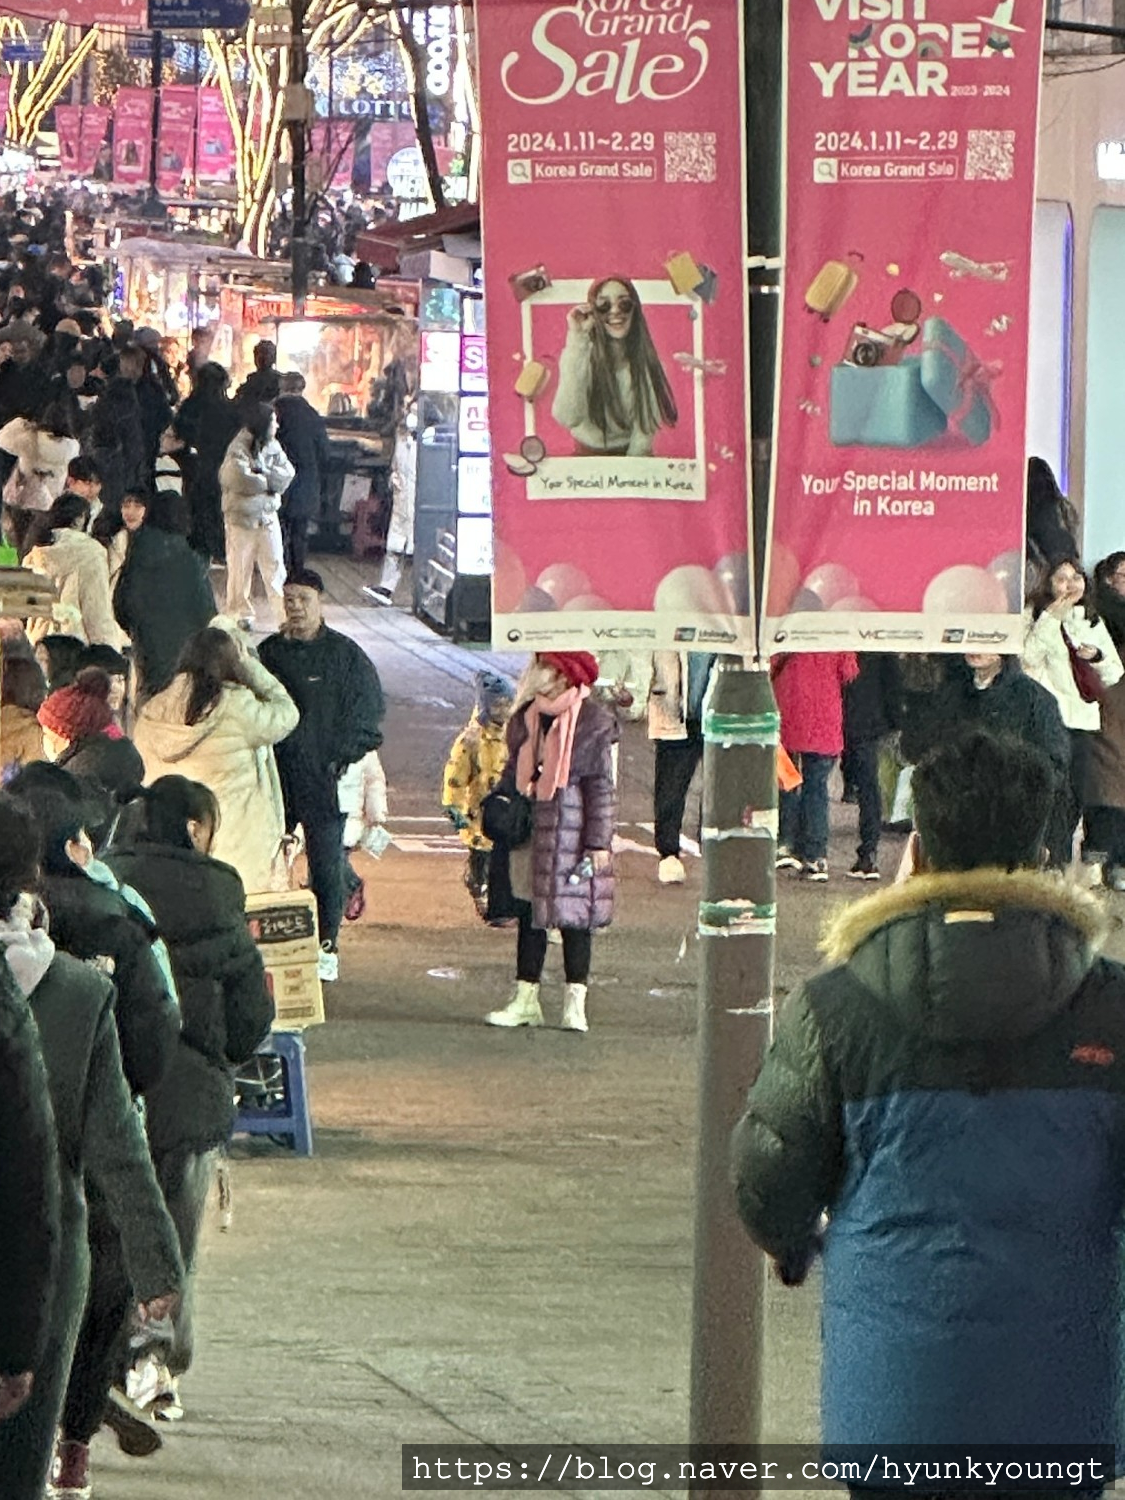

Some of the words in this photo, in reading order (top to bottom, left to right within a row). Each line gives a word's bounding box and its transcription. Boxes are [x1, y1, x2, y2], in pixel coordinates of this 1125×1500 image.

[584, 4, 694, 38] Grand
[501, 5, 711, 105] Sale
[809, 61, 949, 98] YEAR
[507, 131, 655, 152] 2024.1.11~2.29
[814, 130, 959, 152] 2024.1.11~2.29
[535, 163, 576, 178] Korea
[579, 161, 619, 178] Grand
[622, 161, 653, 177] Sale
[840, 162, 881, 178] Korea
[884, 161, 925, 177] Grand
[928, 160, 954, 177] Sale
[542, 478, 562, 491] Your
[567, 475, 605, 491] Special
[608, 476, 649, 489] Moment
[653, 476, 661, 489] in
[665, 476, 694, 491] Korea
[801, 473, 839, 495] Your
[843, 470, 916, 494] Special
[920, 471, 999, 493] Moment
[853, 496, 871, 516] in
[877, 496, 935, 516] Korea
